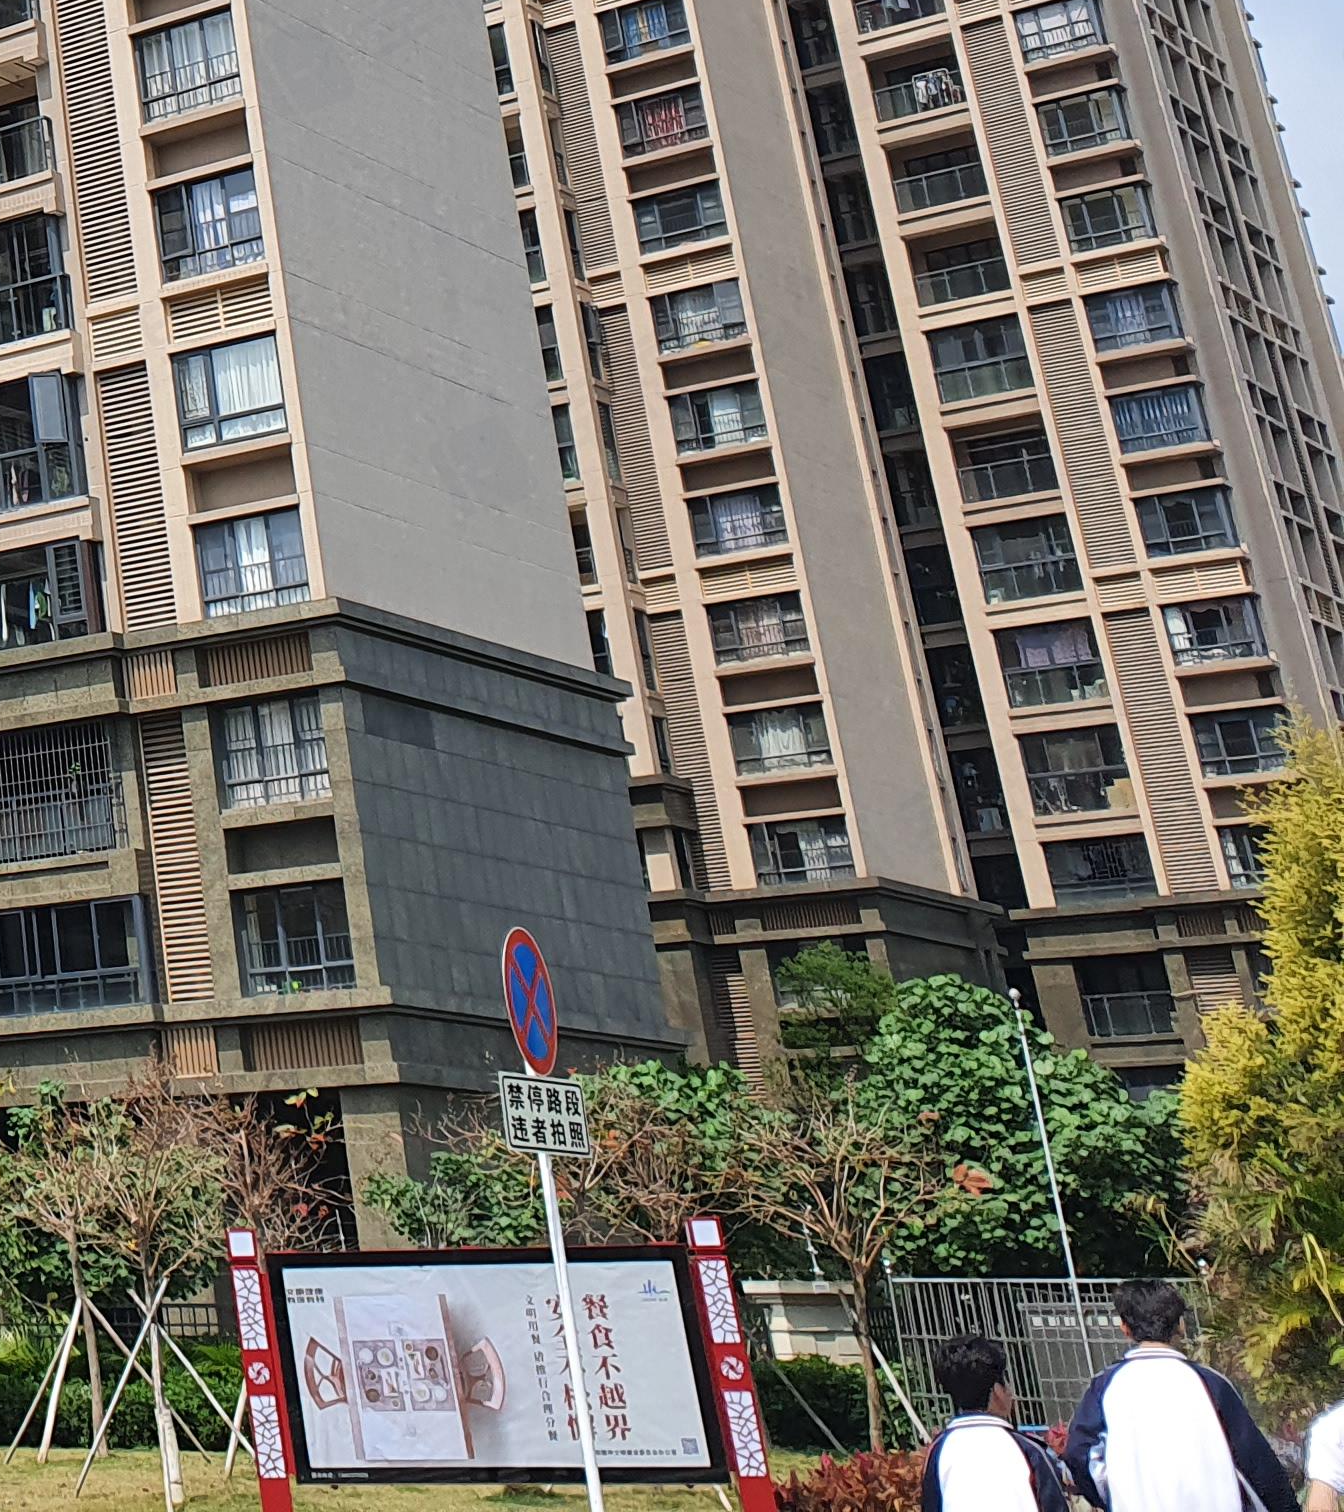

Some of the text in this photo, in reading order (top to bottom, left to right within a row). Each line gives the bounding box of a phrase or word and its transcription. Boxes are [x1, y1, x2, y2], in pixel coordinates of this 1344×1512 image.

[507, 1082, 582, 1117] 禁停路段
[511, 1115, 585, 1149] 违者拍照
[581, 1293, 632, 1441] 餐食不越界
